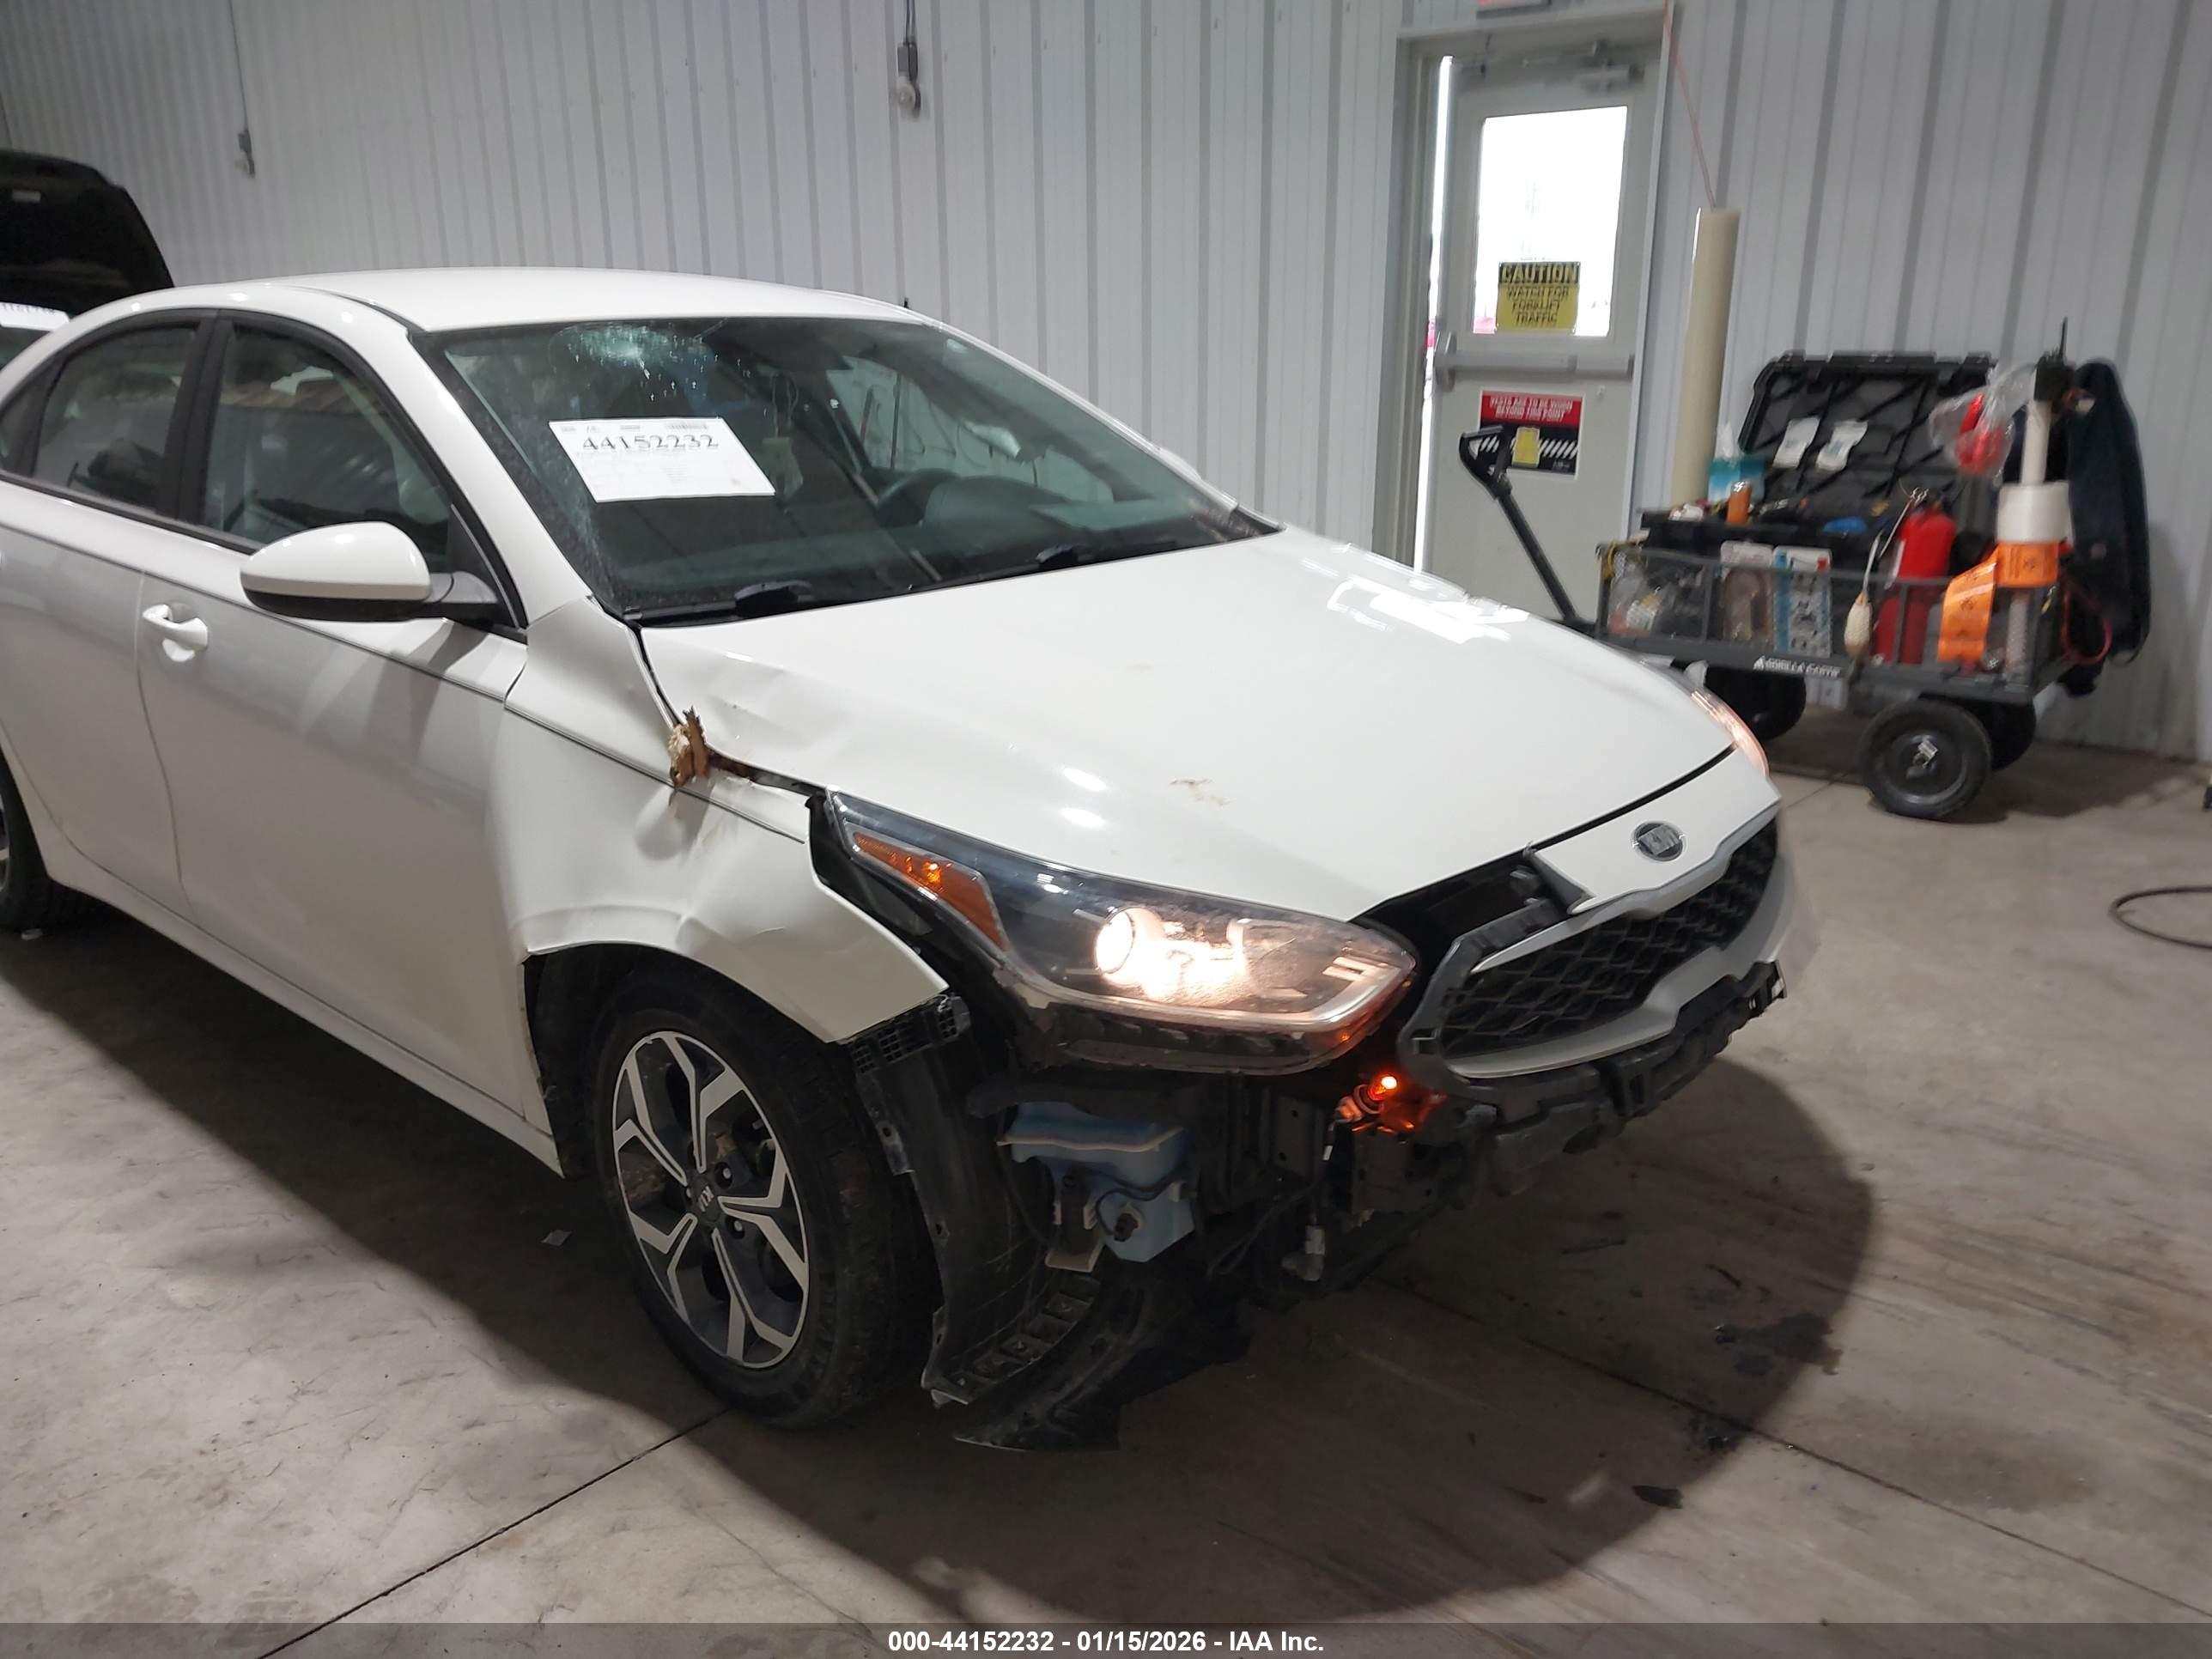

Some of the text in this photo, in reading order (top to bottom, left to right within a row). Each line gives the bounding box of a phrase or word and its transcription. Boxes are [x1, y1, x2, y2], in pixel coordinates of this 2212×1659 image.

[1501, 263, 1578, 283] CAUTION
[1507, 285, 1570, 299] WATCH FOR
[1512, 299, 1561, 312] FORKLIFT
[1516, 312, 1558, 325] TRAFFIC
[582, 434, 720, 451] 44152232
